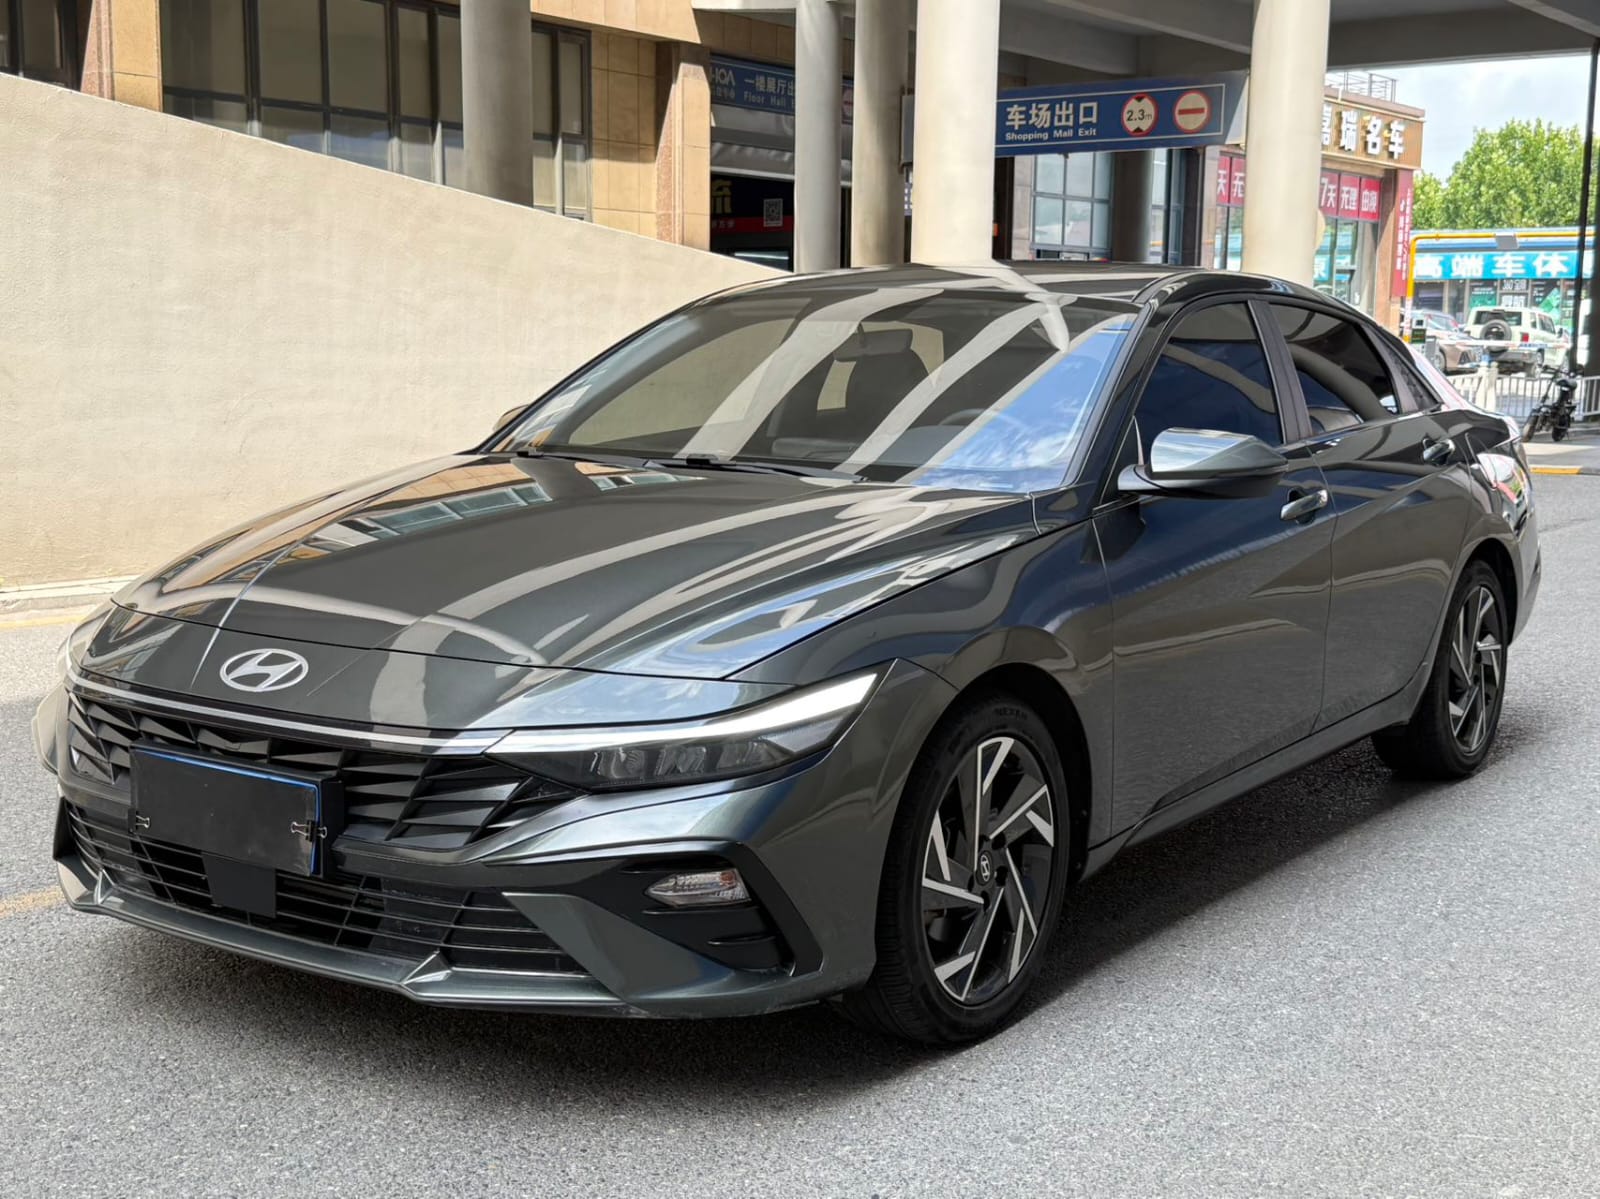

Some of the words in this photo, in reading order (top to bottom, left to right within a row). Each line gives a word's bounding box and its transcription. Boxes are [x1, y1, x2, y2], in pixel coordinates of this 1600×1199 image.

[743, 91, 765, 105] Floor
[770, 95, 786, 108] Hall
[1005, 100, 1098, 130] 车场出口
[1126, 109, 1153, 122] 2.3m
[1005, 131, 1049, 142] Shopping
[1052, 129, 1073, 138] Mall
[1078, 127, 1097, 137] Exit
